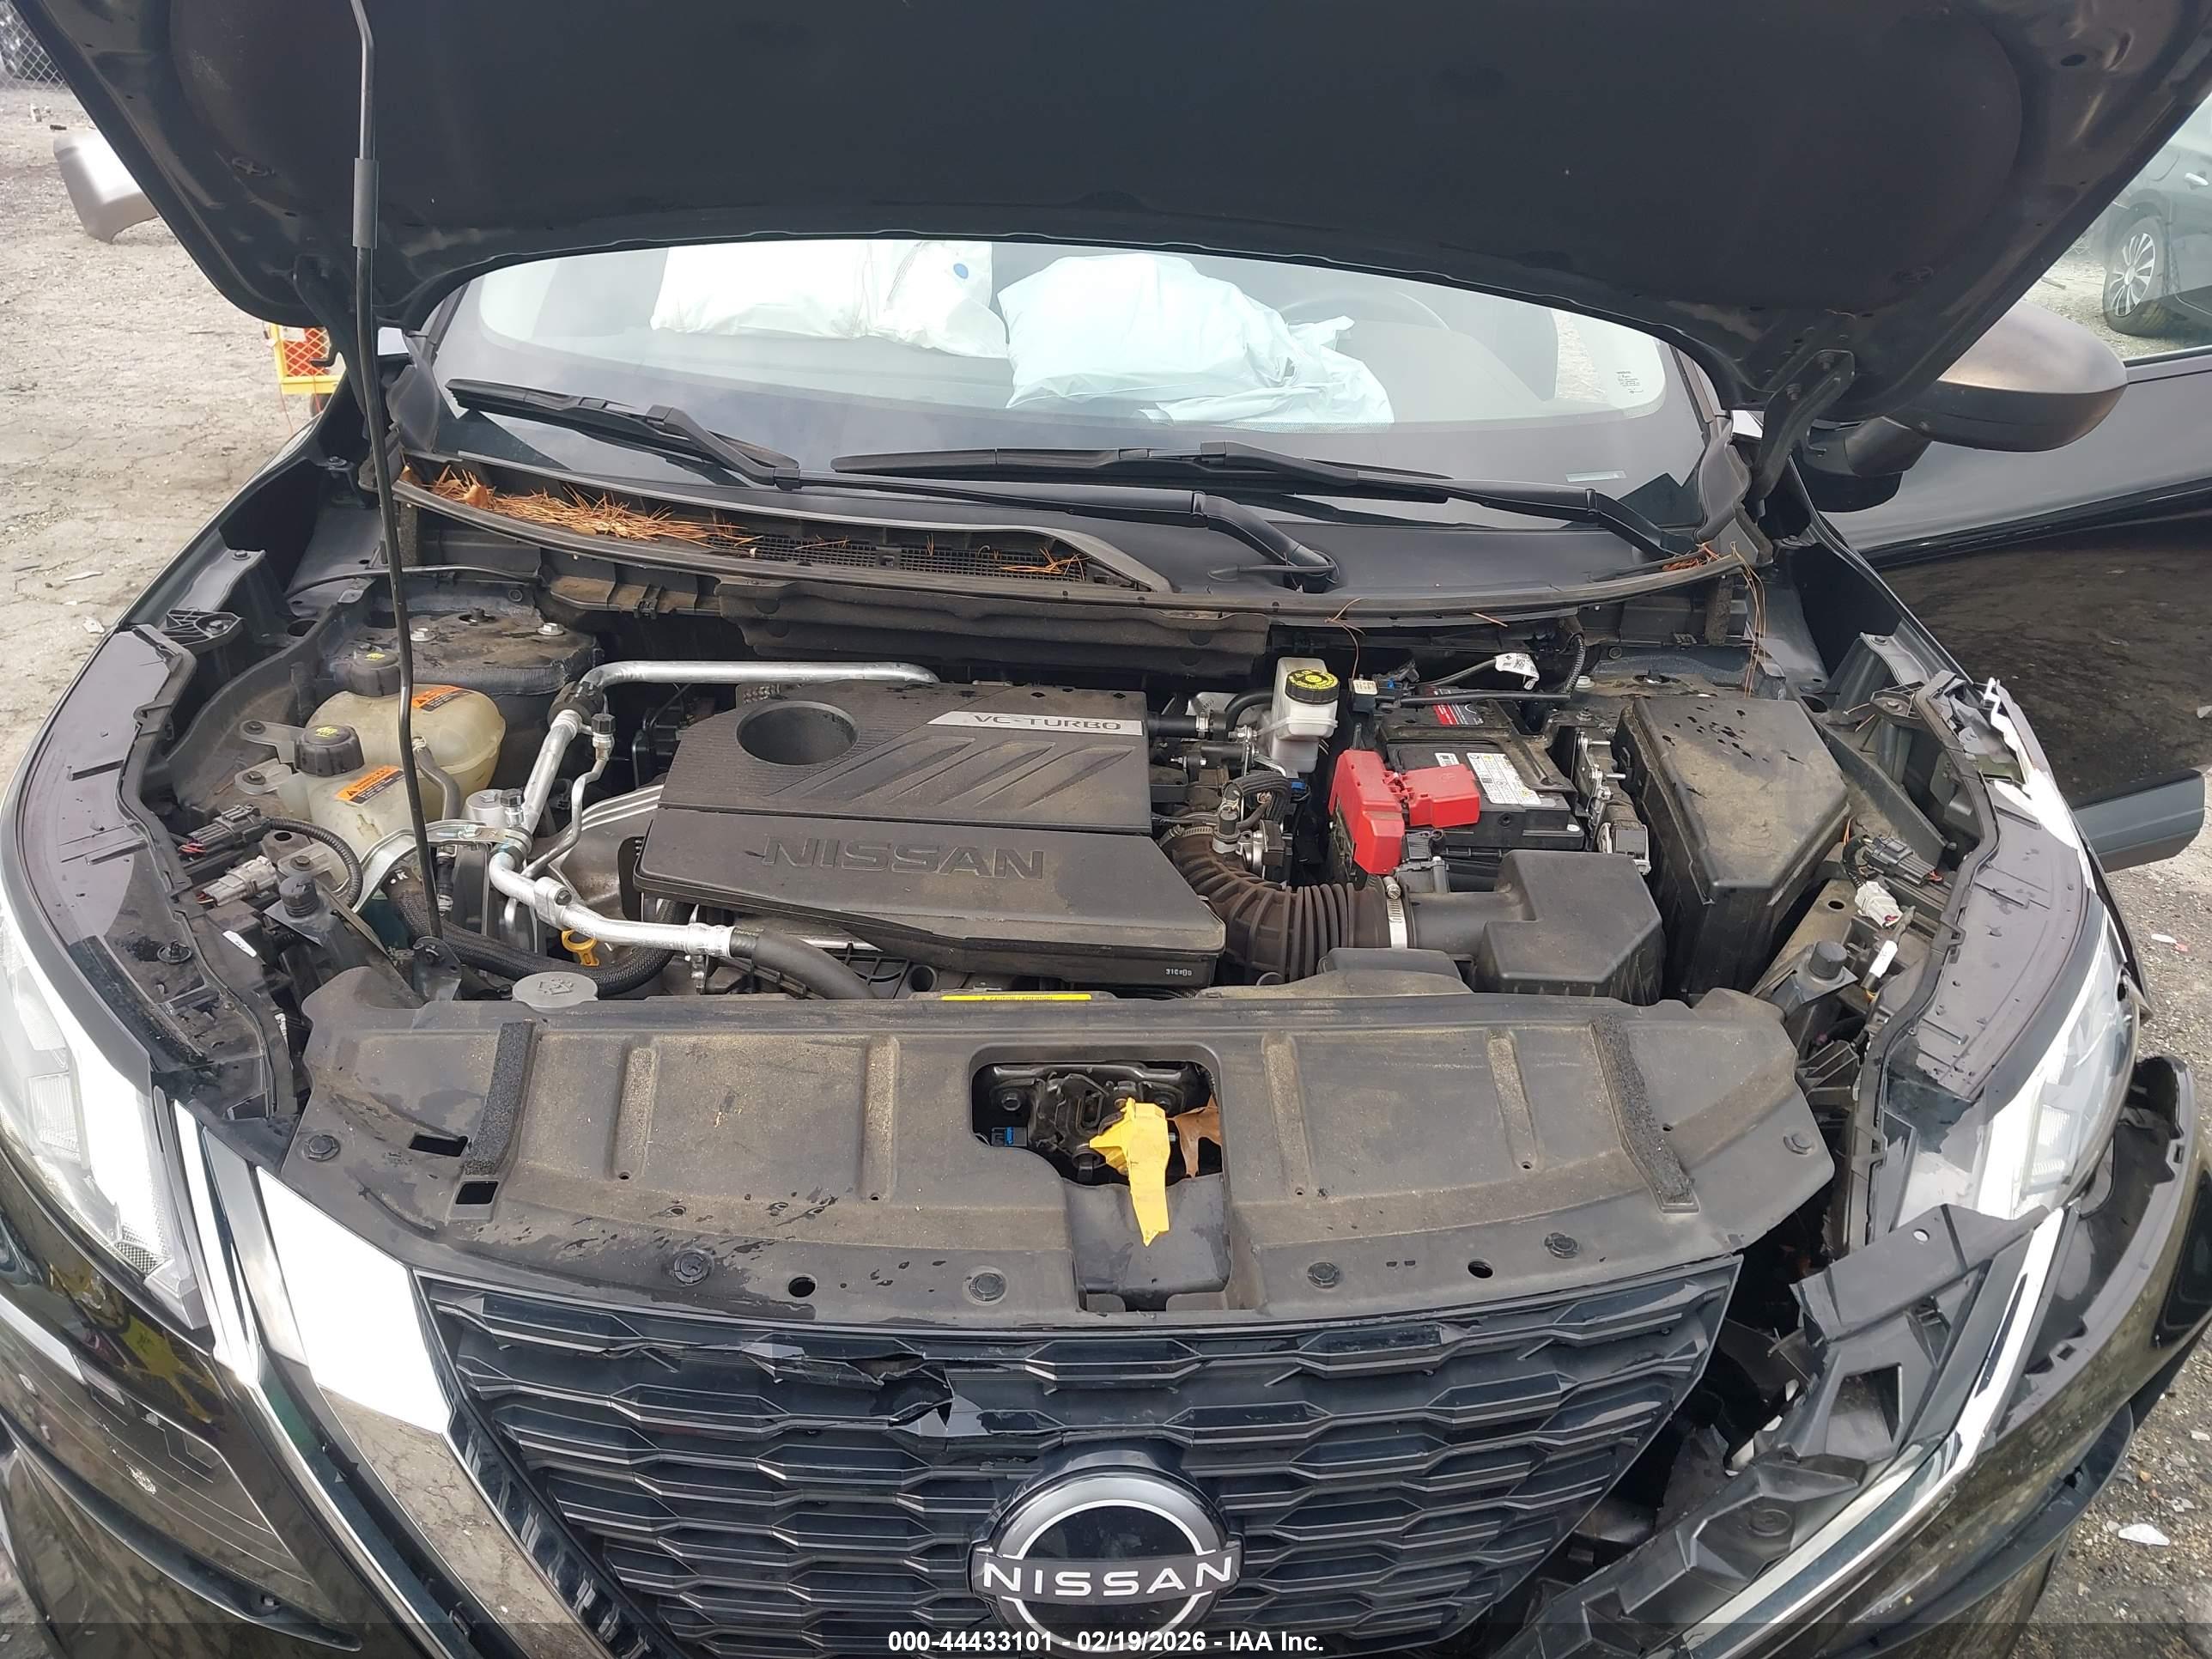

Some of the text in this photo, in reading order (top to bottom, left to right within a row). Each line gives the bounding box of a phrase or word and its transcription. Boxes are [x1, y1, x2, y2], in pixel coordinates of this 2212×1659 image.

[973, 714, 1121, 730] VC-TURBO
[762, 836, 1044, 880] NISSAN
[983, 1556, 1232, 1597] NISSAN
